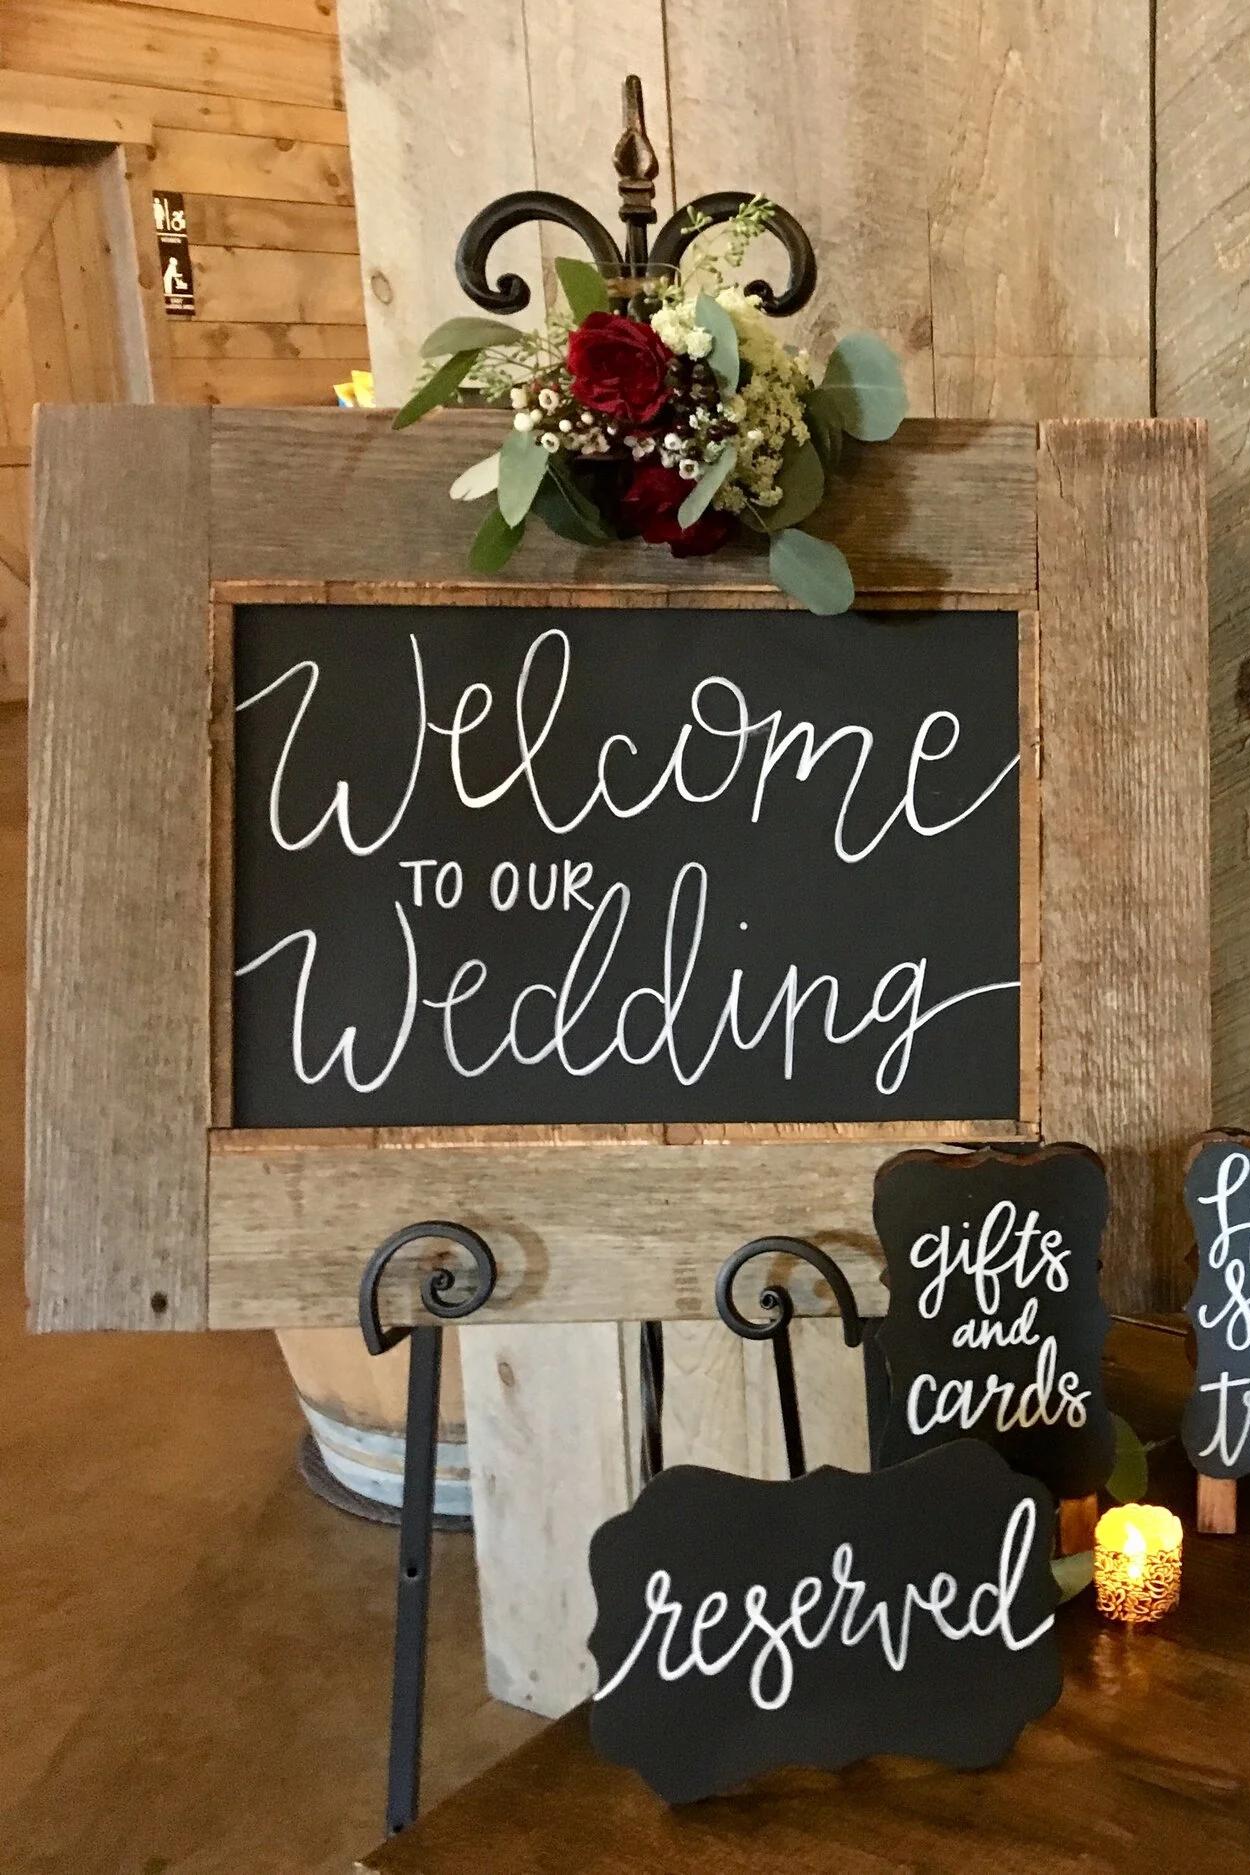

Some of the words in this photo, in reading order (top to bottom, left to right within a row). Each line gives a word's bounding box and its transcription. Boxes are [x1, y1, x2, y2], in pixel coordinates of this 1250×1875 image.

[236, 629, 1020, 862] Welcome
[400, 860, 462, 909] TO
[490, 861, 595, 911] OUR
[235, 862, 1020, 1095] Wedding
[910, 1200, 1071, 1319] gifts
[952, 1297, 1040, 1350] and
[907, 1335, 1092, 1435] cards
[594, 1498, 1056, 1710] reserved
